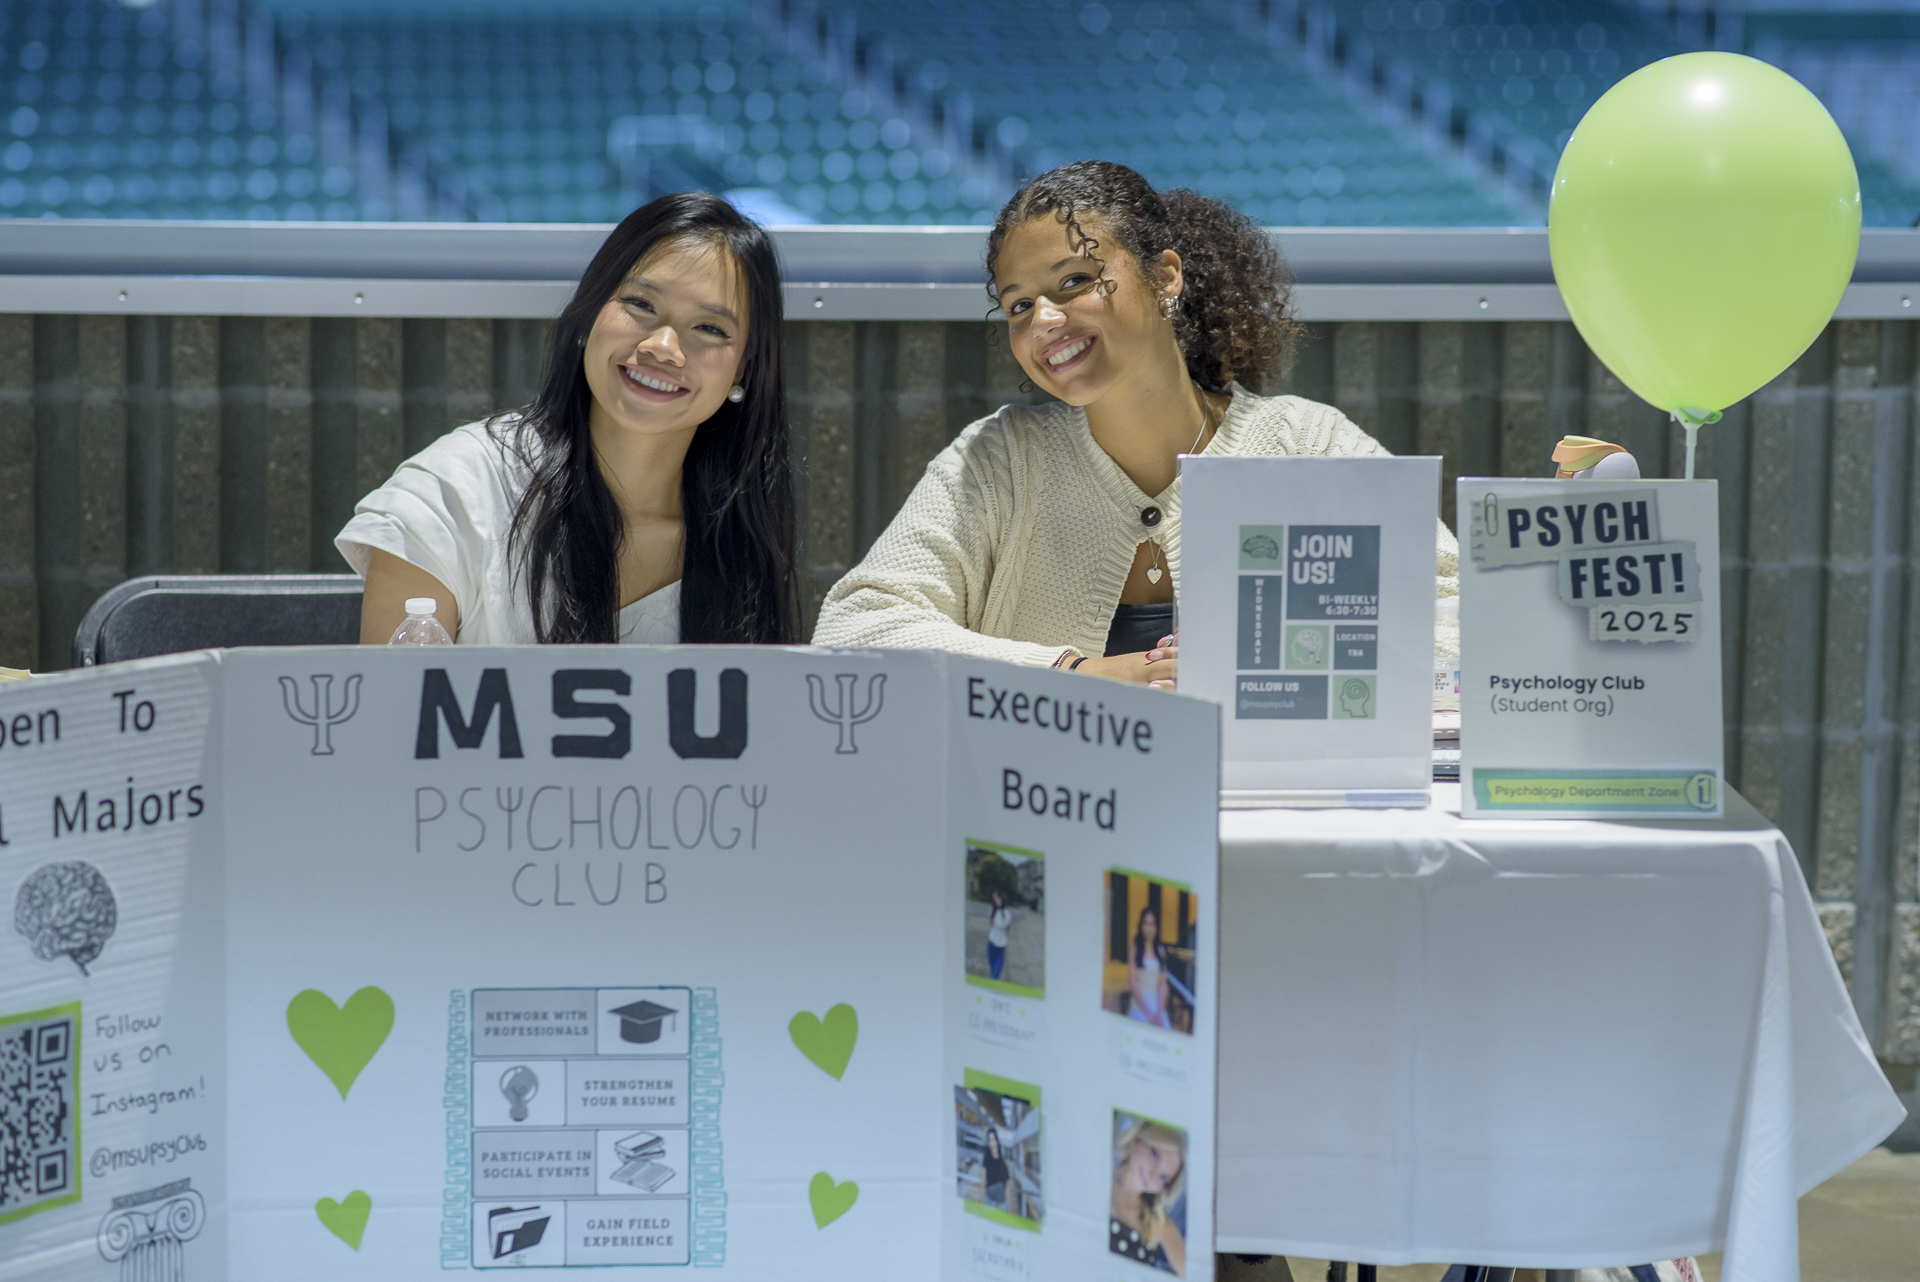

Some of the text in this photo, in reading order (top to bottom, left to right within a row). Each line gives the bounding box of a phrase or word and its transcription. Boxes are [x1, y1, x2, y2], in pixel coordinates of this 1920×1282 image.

[1507, 500, 1649, 548] PSYCH
[1292, 534, 1353, 559] JOIN
[1292, 561, 1336, 584] US!
[1569, 552, 1685, 599] FEST!
[1318, 595, 1377, 605] BI-WEEKLY
[1325, 605, 1377, 616] 6:30-7:30
[1253, 578, 1265, 664] WEDNESDAYS
[1600, 610, 1693, 634] 2025
[1336, 633, 1376, 642] LOCATION
[1347, 649, 1364, 657] TBA
[1240, 682, 1299, 692] FOLLOW US
[1490, 675, 1645, 694] Psychology Club
[112, 689, 155, 732] To
[413, 667, 748, 760] MSU
[967, 676, 1153, 753] Executive
[1491, 694, 1614, 717] (Student Org)
[1002, 767, 1116, 833] Board
[1495, 785, 1680, 798] Psychology Department Zone
[53, 776, 204, 838] Majors
[415, 784, 768, 853] PSYCHOLOGY
[511, 862, 669, 907] CLUB
[95, 1014, 161, 1038] Follow
[485, 1010, 588, 1022] NETWORK WITH
[484, 1025, 589, 1038] PROFESSIONALS
[138, 1043, 172, 1063] on
[90, 1075, 205, 1116] Instagram!
[584, 1079, 674, 1091] STRENGTHEN
[581, 1095, 677, 1107] YOUR RESUME
[481, 1150, 592, 1162] PARTICIPATE IN
[482, 1166, 590, 1179] SOCIAL EVENTS
[586, 1218, 670, 1230] GAIN FIELD
[583, 1235, 674, 1248] EXPERIENCE
